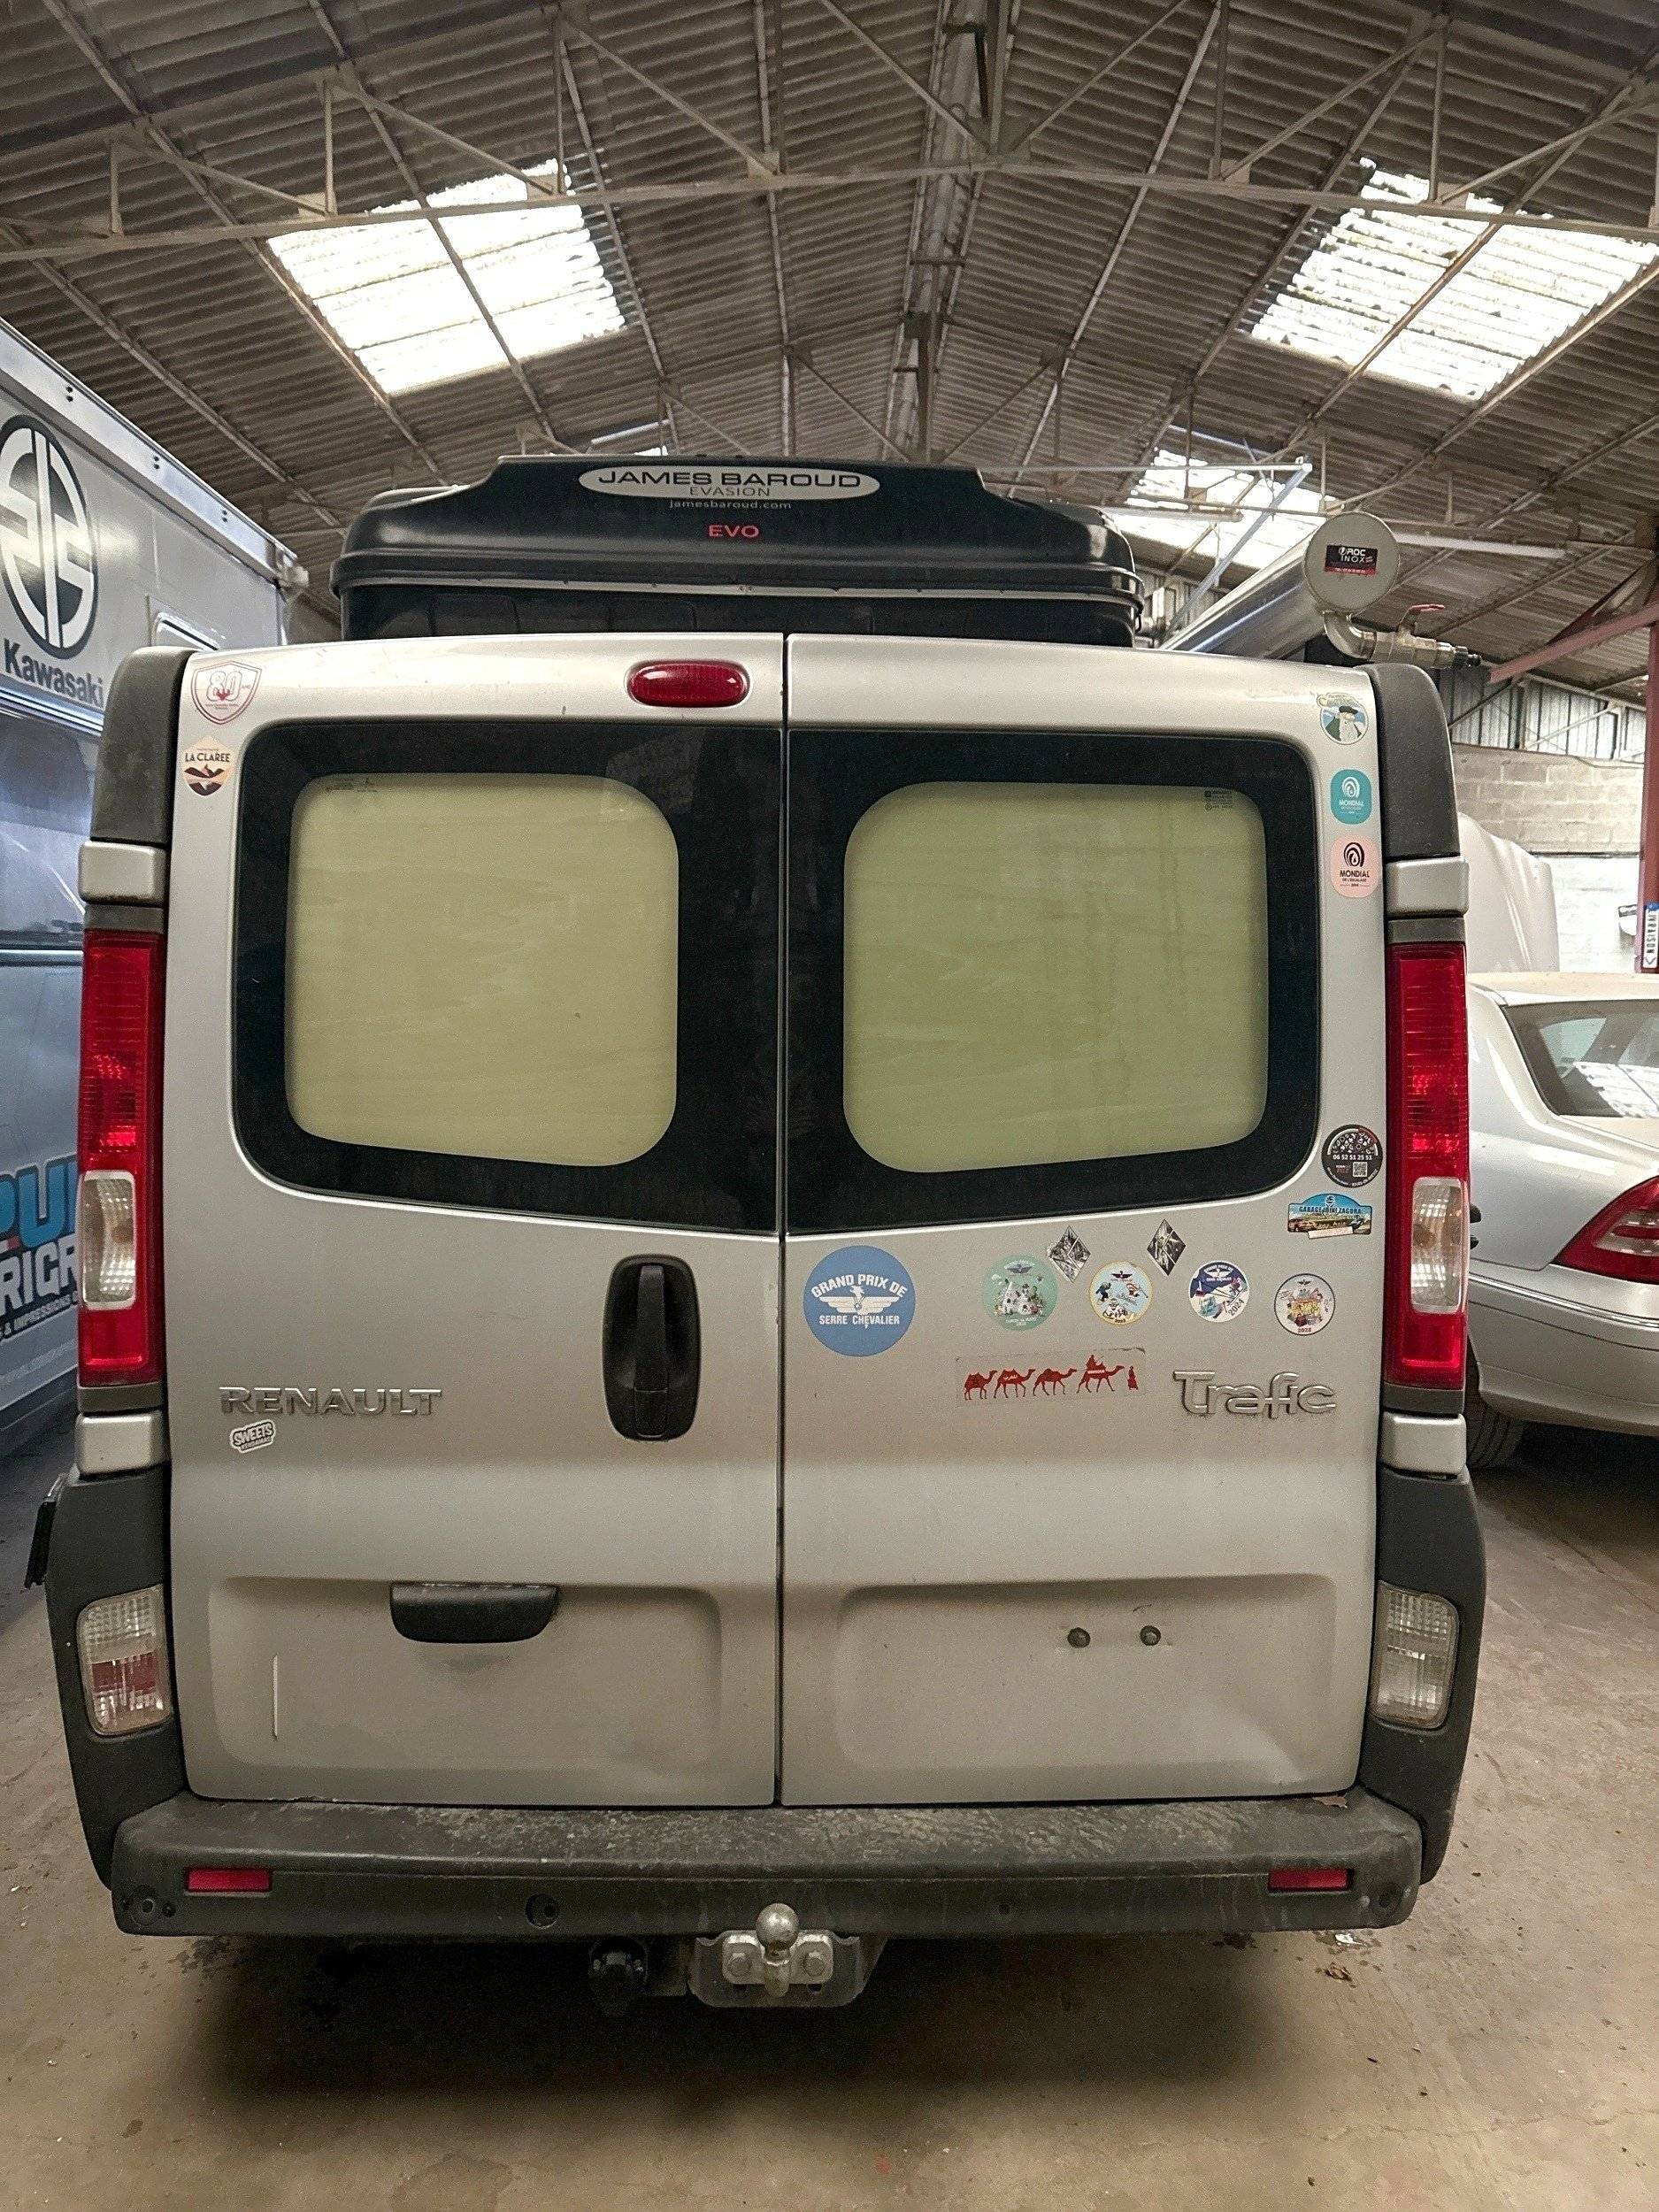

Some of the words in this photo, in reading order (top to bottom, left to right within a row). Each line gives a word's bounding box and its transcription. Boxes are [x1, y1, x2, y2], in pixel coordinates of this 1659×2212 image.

[598, 471, 712, 486] JAMES
[721, 472, 861, 488] BAROUD
[690, 487, 770, 496] EVASION
[670, 500, 792, 510] jamesbaroud.com
[709, 524, 760, 538] EVO
[4, 637, 104, 709] Kawasaki
[205, 670, 242, 702] 80
[185, 752, 196, 762] LA
[1340, 869, 1371, 878] MONDIAL
[810, 1274, 855, 1298] GRAND
[857, 1274, 889, 1289] PRIX
[889, 1281, 908, 1298] DE
[818, 1315, 848, 1325] SERRE
[852, 1315, 900, 1325] CHEVALIER
[219, 1386, 442, 1416] RENAULT
[1173, 1371, 1337, 1419] Trafic
[233, 1422, 274, 1446] SWEETS
